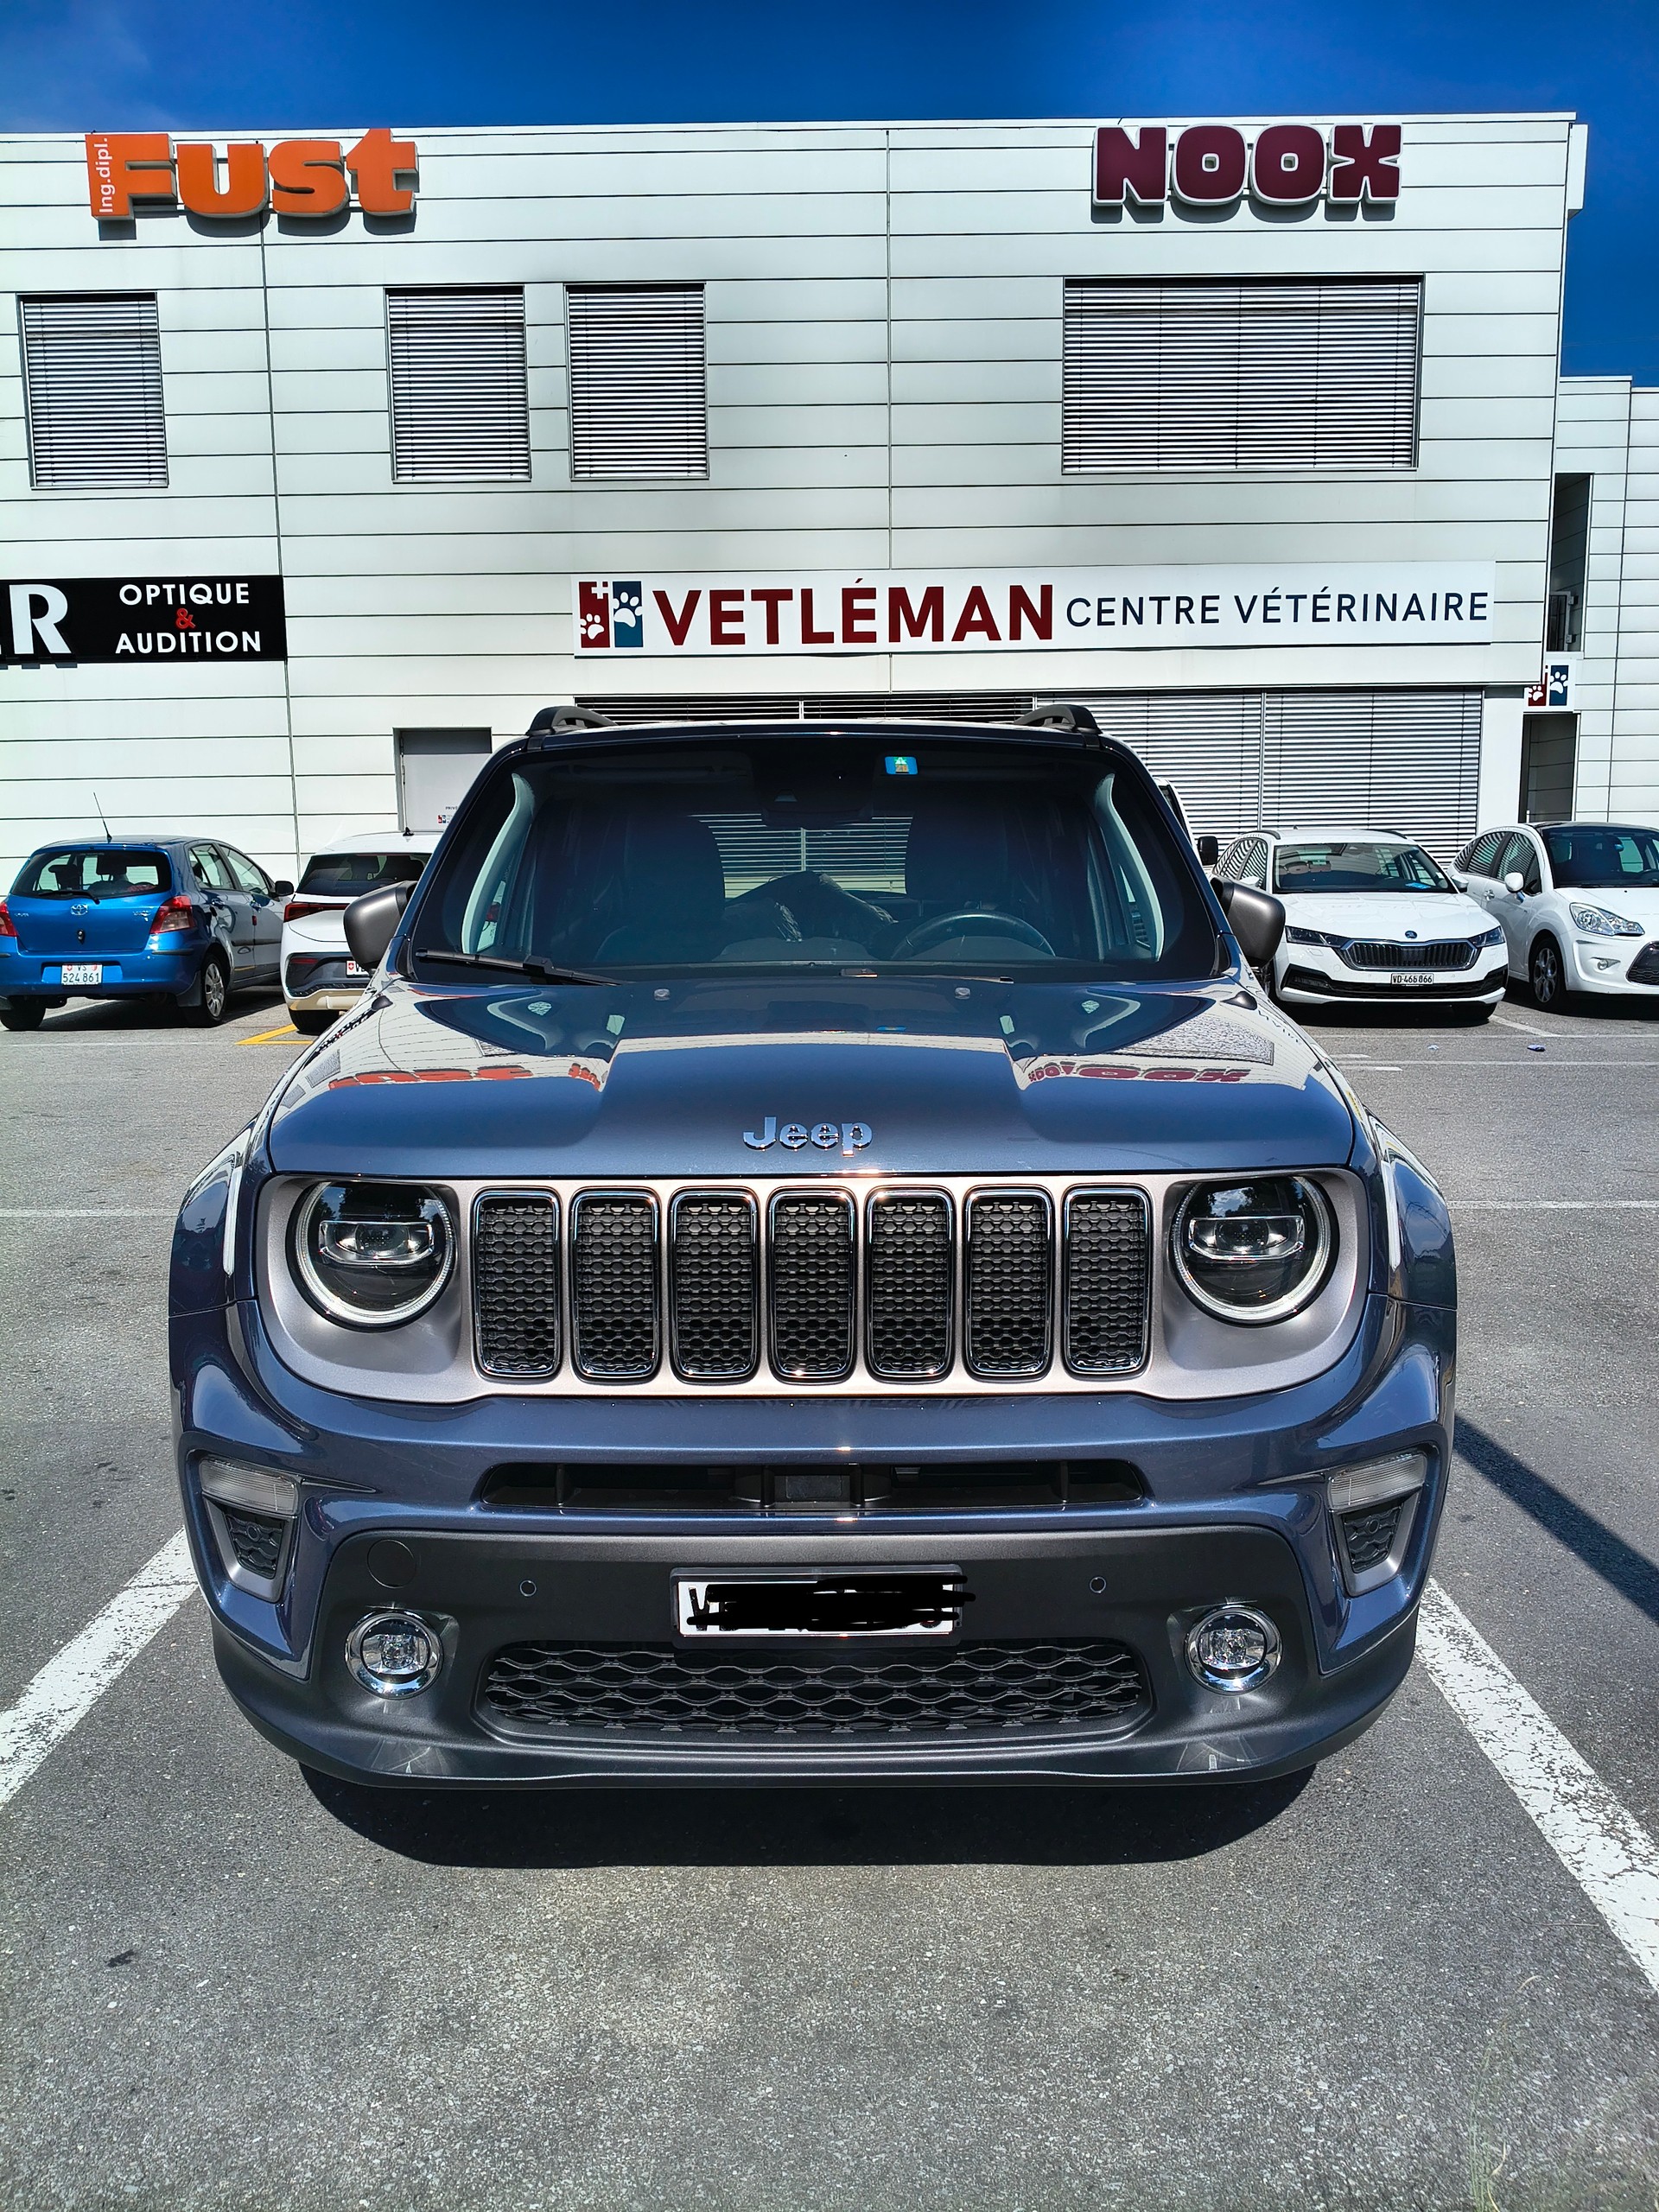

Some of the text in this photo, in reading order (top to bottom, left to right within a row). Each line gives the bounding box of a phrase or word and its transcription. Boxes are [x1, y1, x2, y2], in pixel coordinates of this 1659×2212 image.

[85, 128, 417, 219] Fust
[93, 137, 115, 213] Ing.dipl.
[1095, 124, 1403, 205] NOOX
[0, 584, 73, 655] R
[119, 583, 250, 605] OPTIQUE
[175, 607, 196, 629] &
[652, 577, 1489, 646] VETLÉMAN CENTRE VÉTÉRINAIRE
[115, 631, 261, 654] AUDITION
[63, 972, 99, 983] 524 861
[743, 1116, 873, 1157] Jeep
